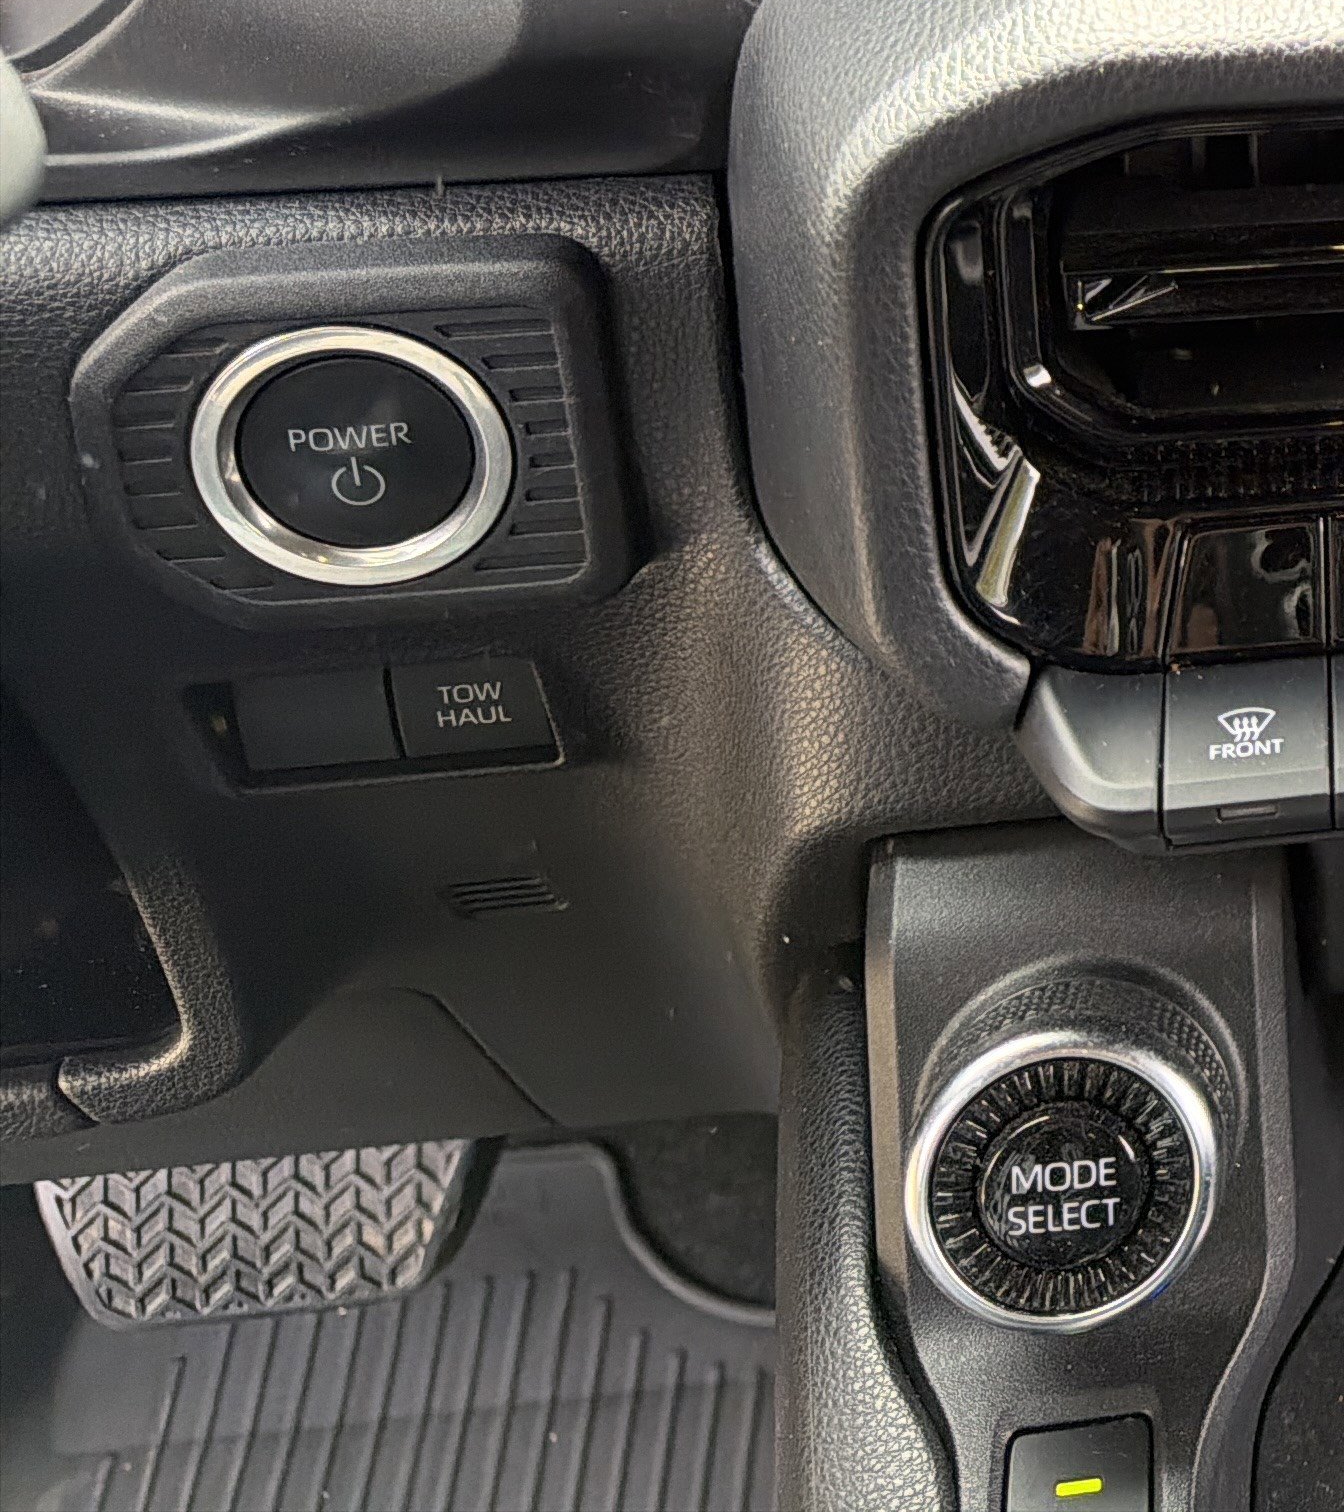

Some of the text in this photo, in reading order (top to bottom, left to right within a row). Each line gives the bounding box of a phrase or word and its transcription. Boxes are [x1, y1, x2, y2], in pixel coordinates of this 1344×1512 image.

[287, 421, 413, 453] POWER
[436, 681, 503, 705] TOW
[435, 704, 513, 729] HAUL
[1208, 737, 1285, 761] FRONT
[1010, 1156, 1118, 1196] MODE
[1006, 1197, 1121, 1238] SELECT
